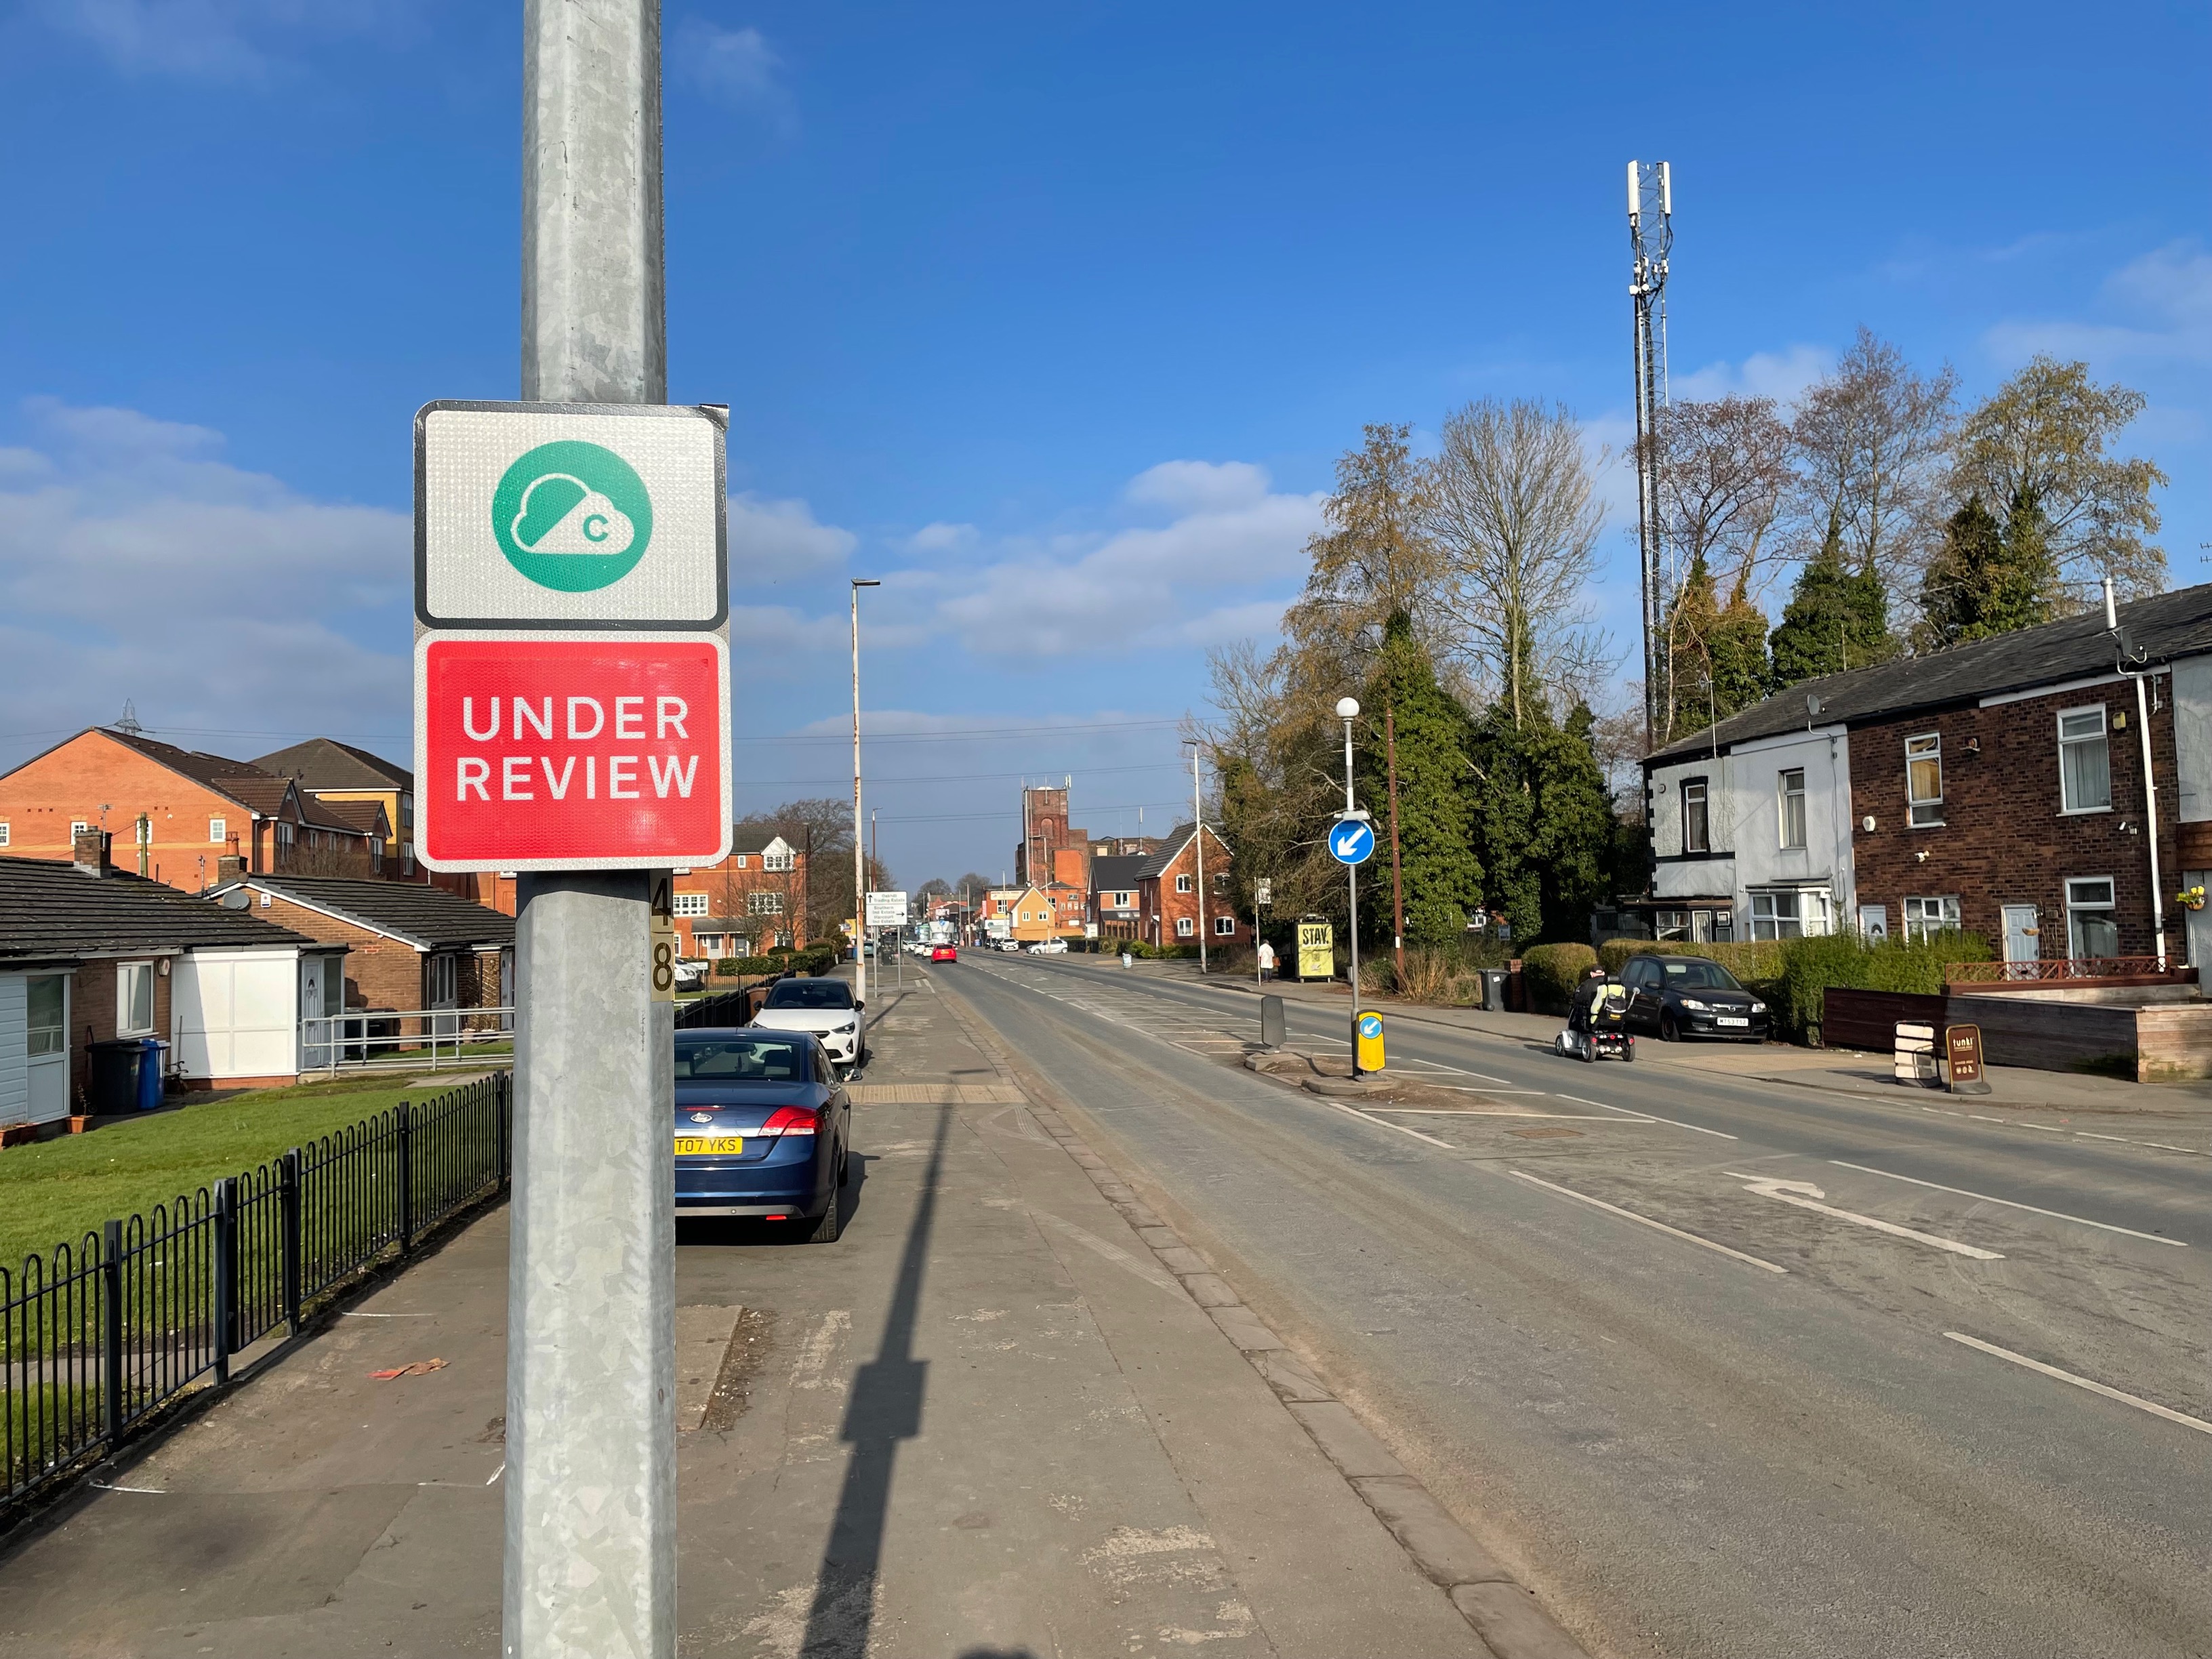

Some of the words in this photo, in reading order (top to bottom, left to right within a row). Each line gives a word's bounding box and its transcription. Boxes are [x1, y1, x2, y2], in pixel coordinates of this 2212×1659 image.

[583, 514, 609, 542] C
[463, 696, 689, 741] UNDER
[457, 755, 699, 802] REVIEW
[652, 878, 672, 926] 4
[1303, 928, 1329, 945] STAY.
[653, 942, 672, 991] 8
[709, 1139, 736, 1151] YKS
